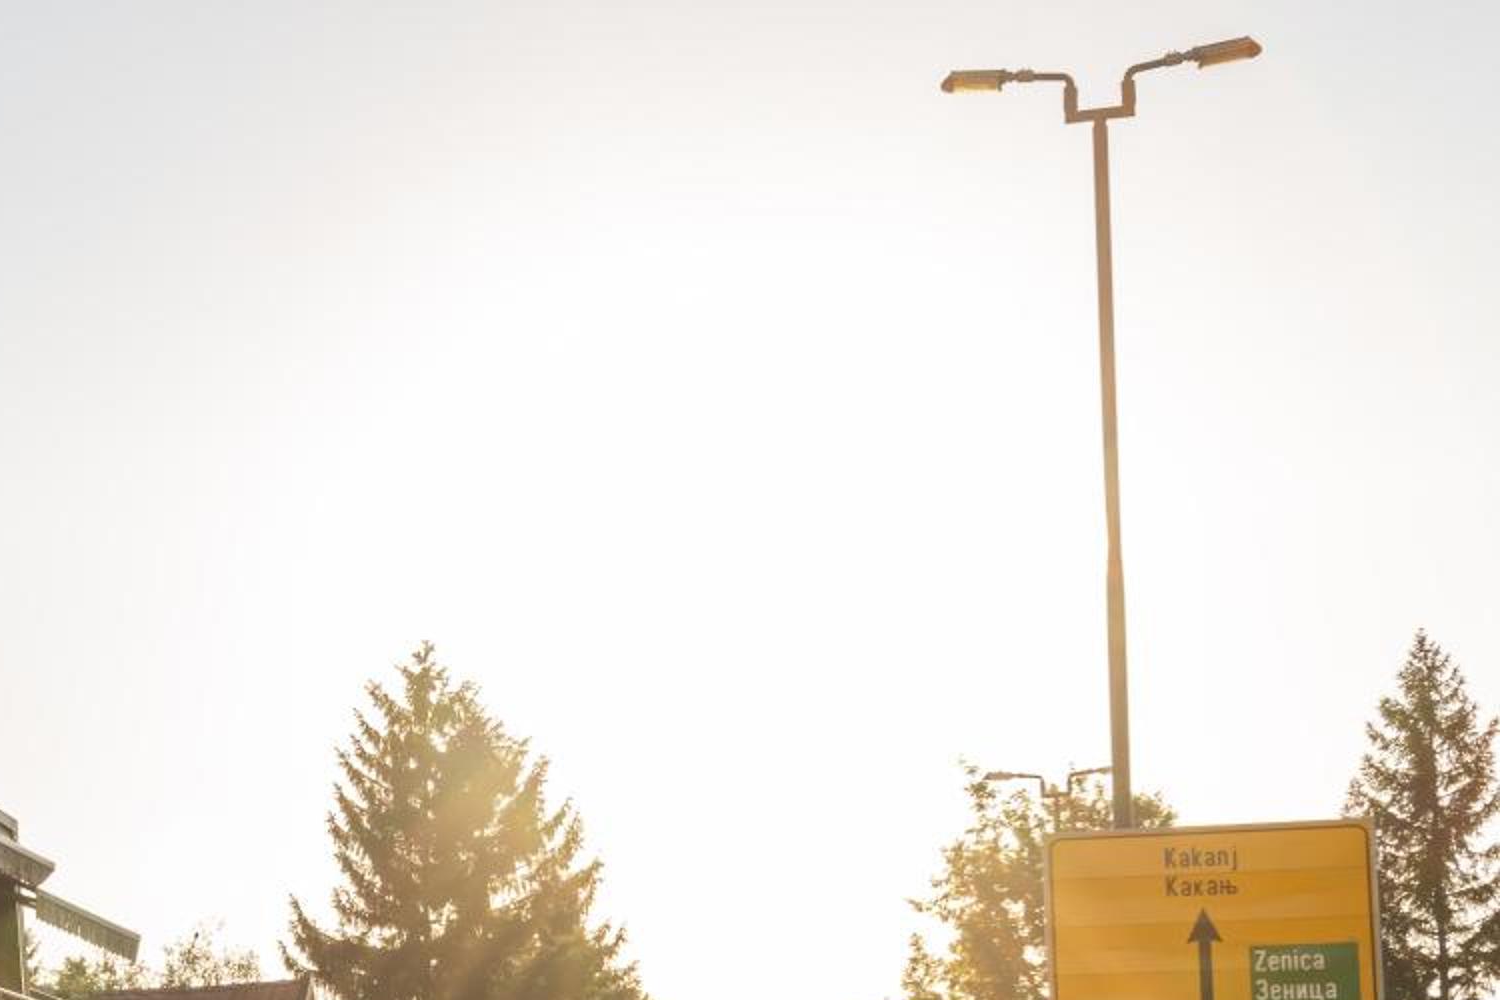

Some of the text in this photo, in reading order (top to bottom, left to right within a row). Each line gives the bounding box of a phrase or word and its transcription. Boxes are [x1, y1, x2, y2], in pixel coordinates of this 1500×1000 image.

[1164, 848, 1237, 871] Kakanj
[1164, 876, 1238, 897] Какањ
[1254, 949, 1325, 972] Zenica
